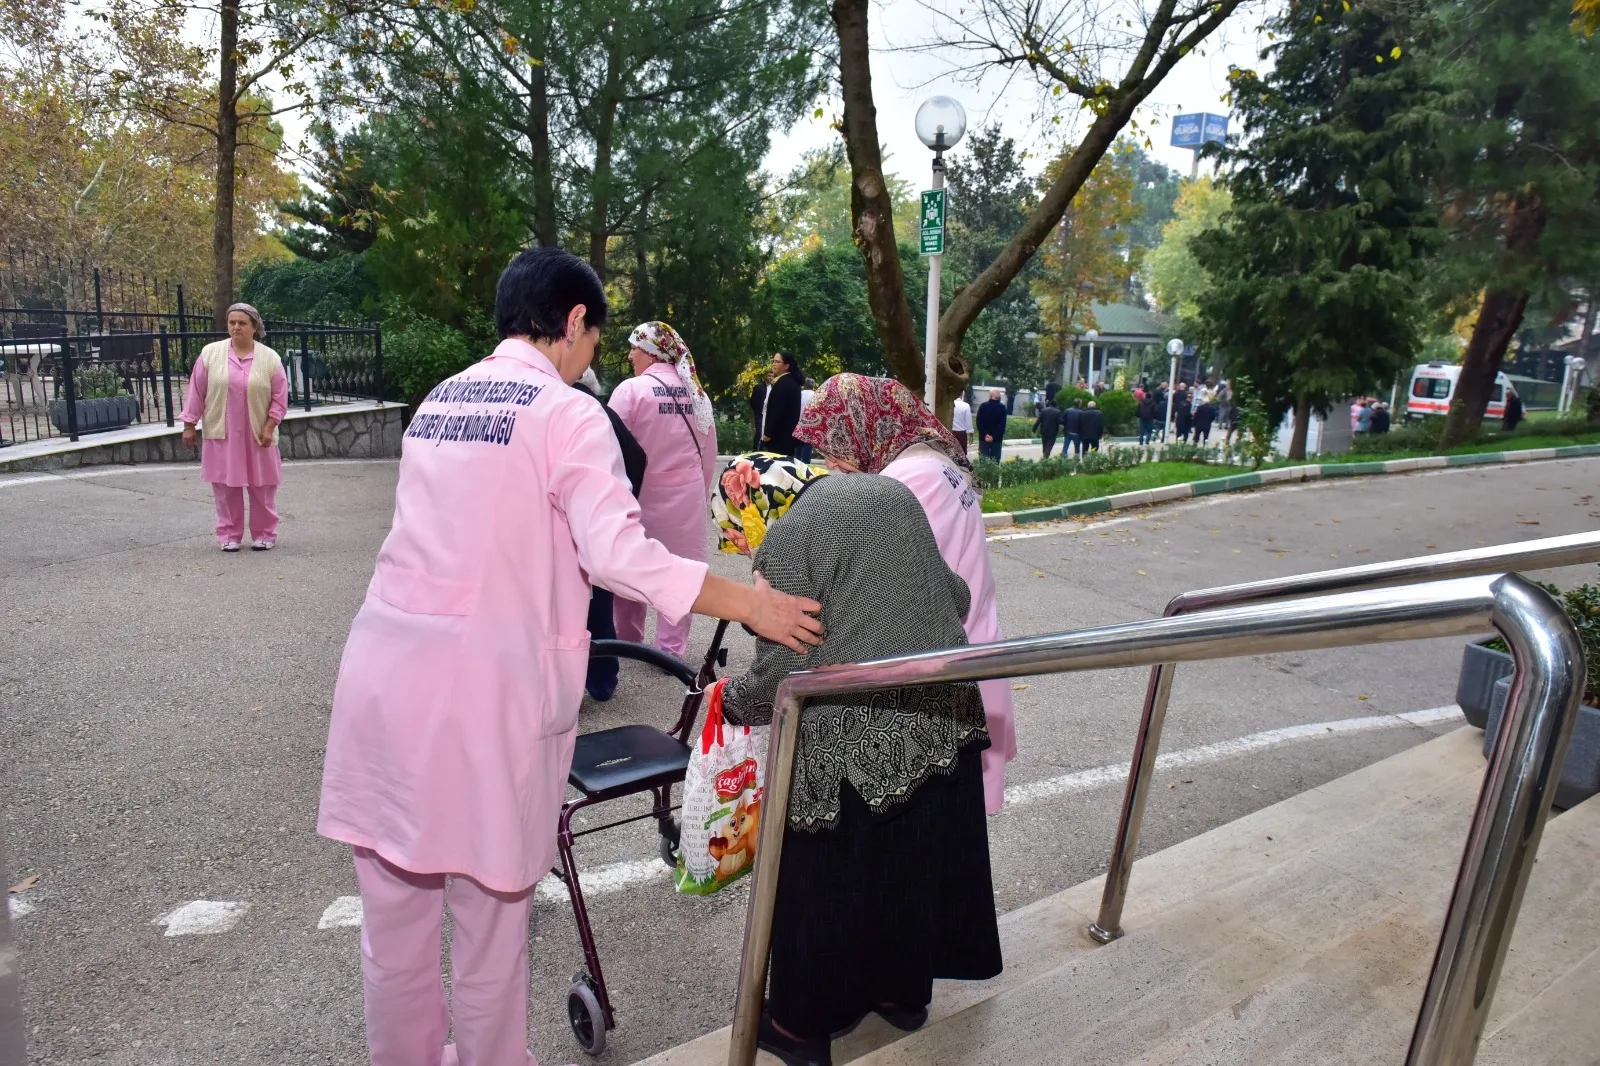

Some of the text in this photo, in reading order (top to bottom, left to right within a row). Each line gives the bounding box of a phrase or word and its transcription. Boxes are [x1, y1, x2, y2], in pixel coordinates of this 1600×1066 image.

[483, 379, 546, 406] BELEDİYESİ
[436, 414, 467, 447] ŞUBE
[459, 408, 517, 447] MÜDÜRLÜĞÜ
